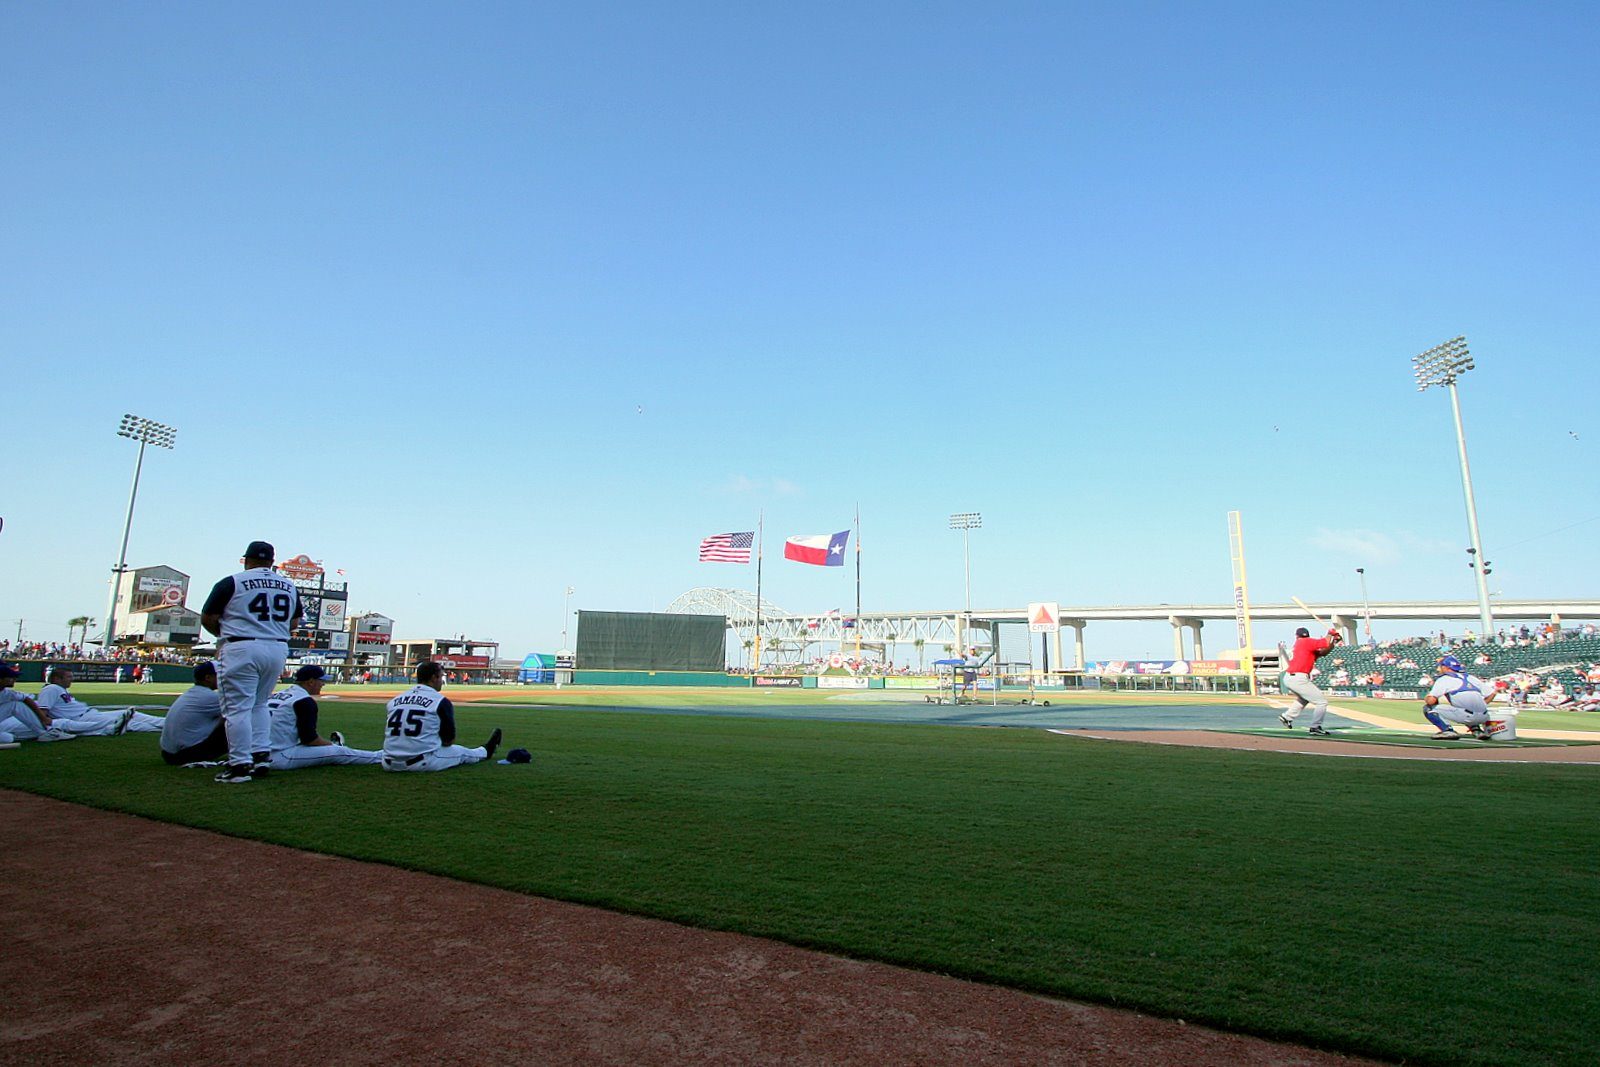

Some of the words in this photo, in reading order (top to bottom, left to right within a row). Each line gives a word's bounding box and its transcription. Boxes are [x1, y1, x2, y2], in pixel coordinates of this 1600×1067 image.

[241, 579, 292, 593] FATHEREE
[248, 593, 290, 622] 49
[393, 696, 433, 708] TAMARGO
[388, 709, 426, 737] 45
